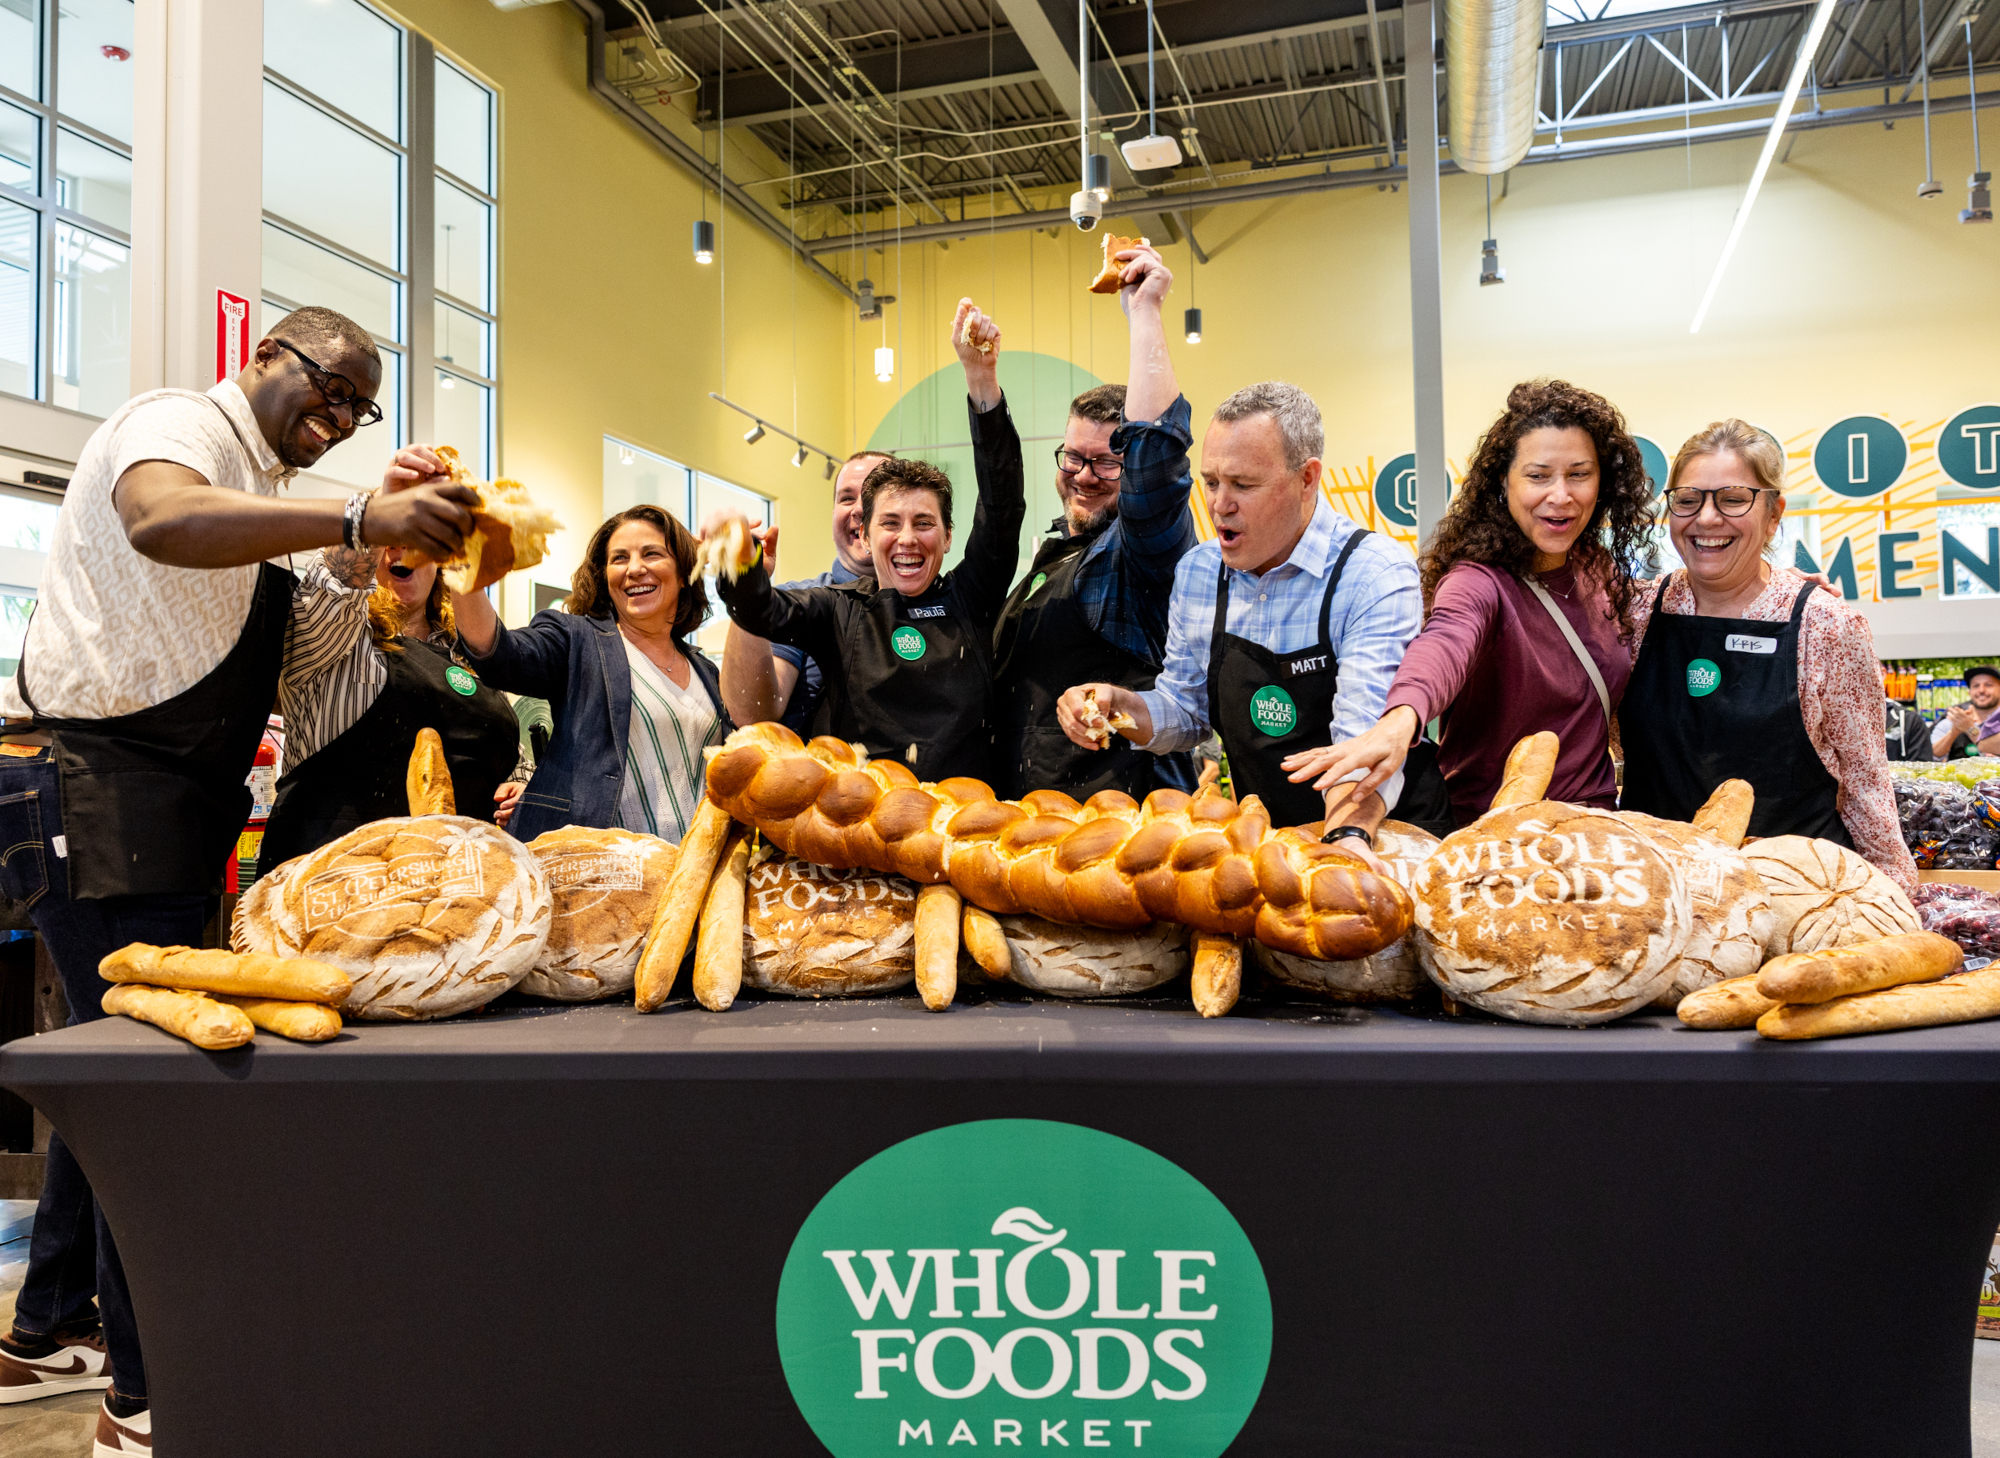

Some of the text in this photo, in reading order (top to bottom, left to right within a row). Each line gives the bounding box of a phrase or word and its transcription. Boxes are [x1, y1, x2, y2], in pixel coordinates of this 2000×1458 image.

[224, 303, 243, 317] FIRE
[914, 605, 946, 618] Paula
[895, 635, 920, 643] WHOLE
[898, 642, 921, 650] FOODS
[1731, 638, 1763, 650] KRIS
[1290, 655, 1327, 675] MATT
[1688, 669, 1716, 678] WHOLE
[1689, 677, 1714, 685] FOODS
[1256, 698, 1292, 713] WHOLE
[1257, 709, 1292, 723] FOODS
[1261, 720, 1287, 728] MARKET
[1434, 827, 1645, 878] WHOLE
[753, 877, 915, 918] FOODS
[1444, 868, 1650, 920] FOODS
[778, 904, 895, 935] MARKET
[1477, 913, 1622, 940] MARKET
[822, 1226, 1218, 1320] WHOLE
[851, 1327, 1207, 1401] FOODS
[899, 1419, 1152, 1447] MARKET
